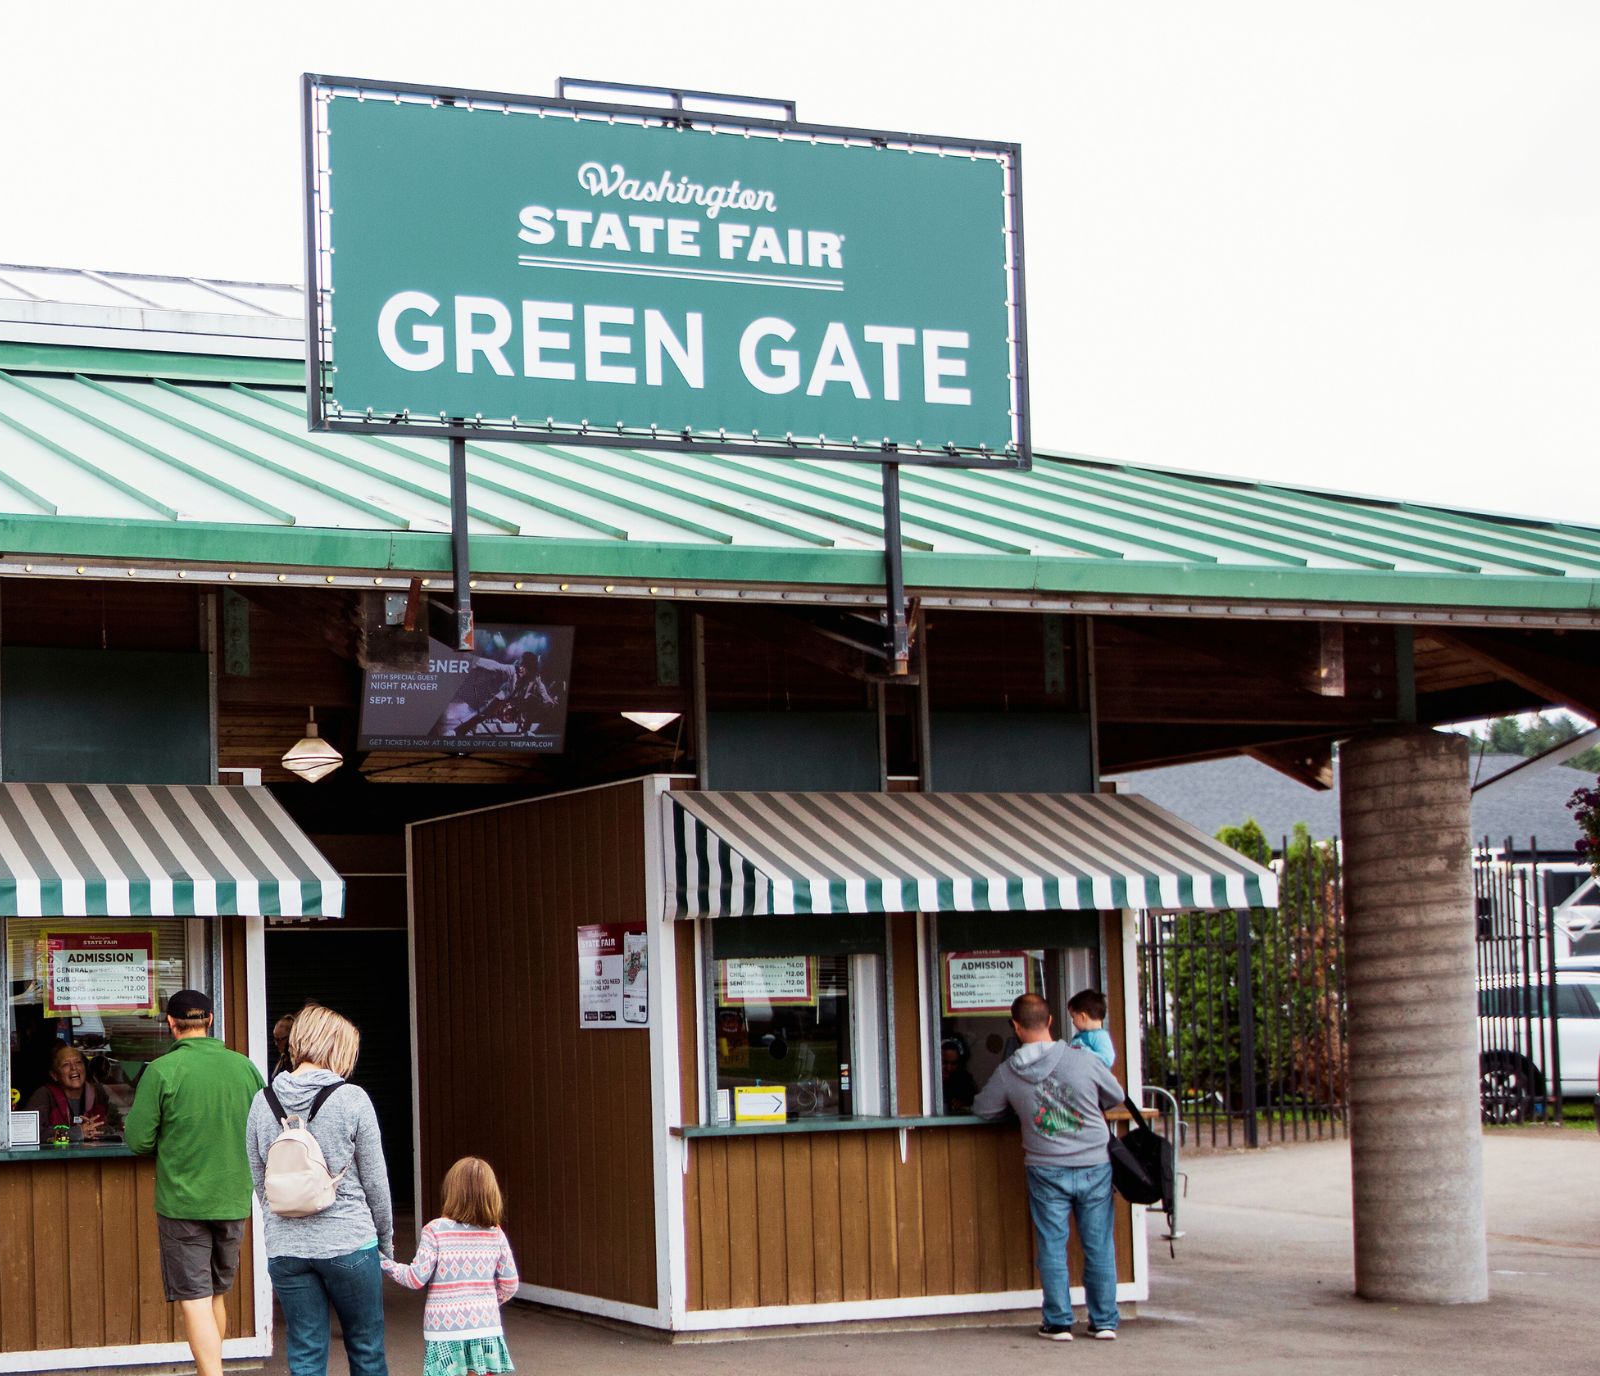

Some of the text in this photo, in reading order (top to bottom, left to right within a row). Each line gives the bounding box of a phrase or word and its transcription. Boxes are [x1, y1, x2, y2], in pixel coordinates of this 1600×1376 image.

[578, 162, 777, 218] Washington
[518, 205, 844, 269] STATE FAIR
[377, 291, 971, 406] GREEN GATE
[371, 682, 438, 690] NIGHT RANGER
[396, 697, 405, 705] 18
[601, 938, 616, 947] FAIR
[68, 953, 134, 963] ADMISSION
[961, 961, 1014, 970] ADMISSION
